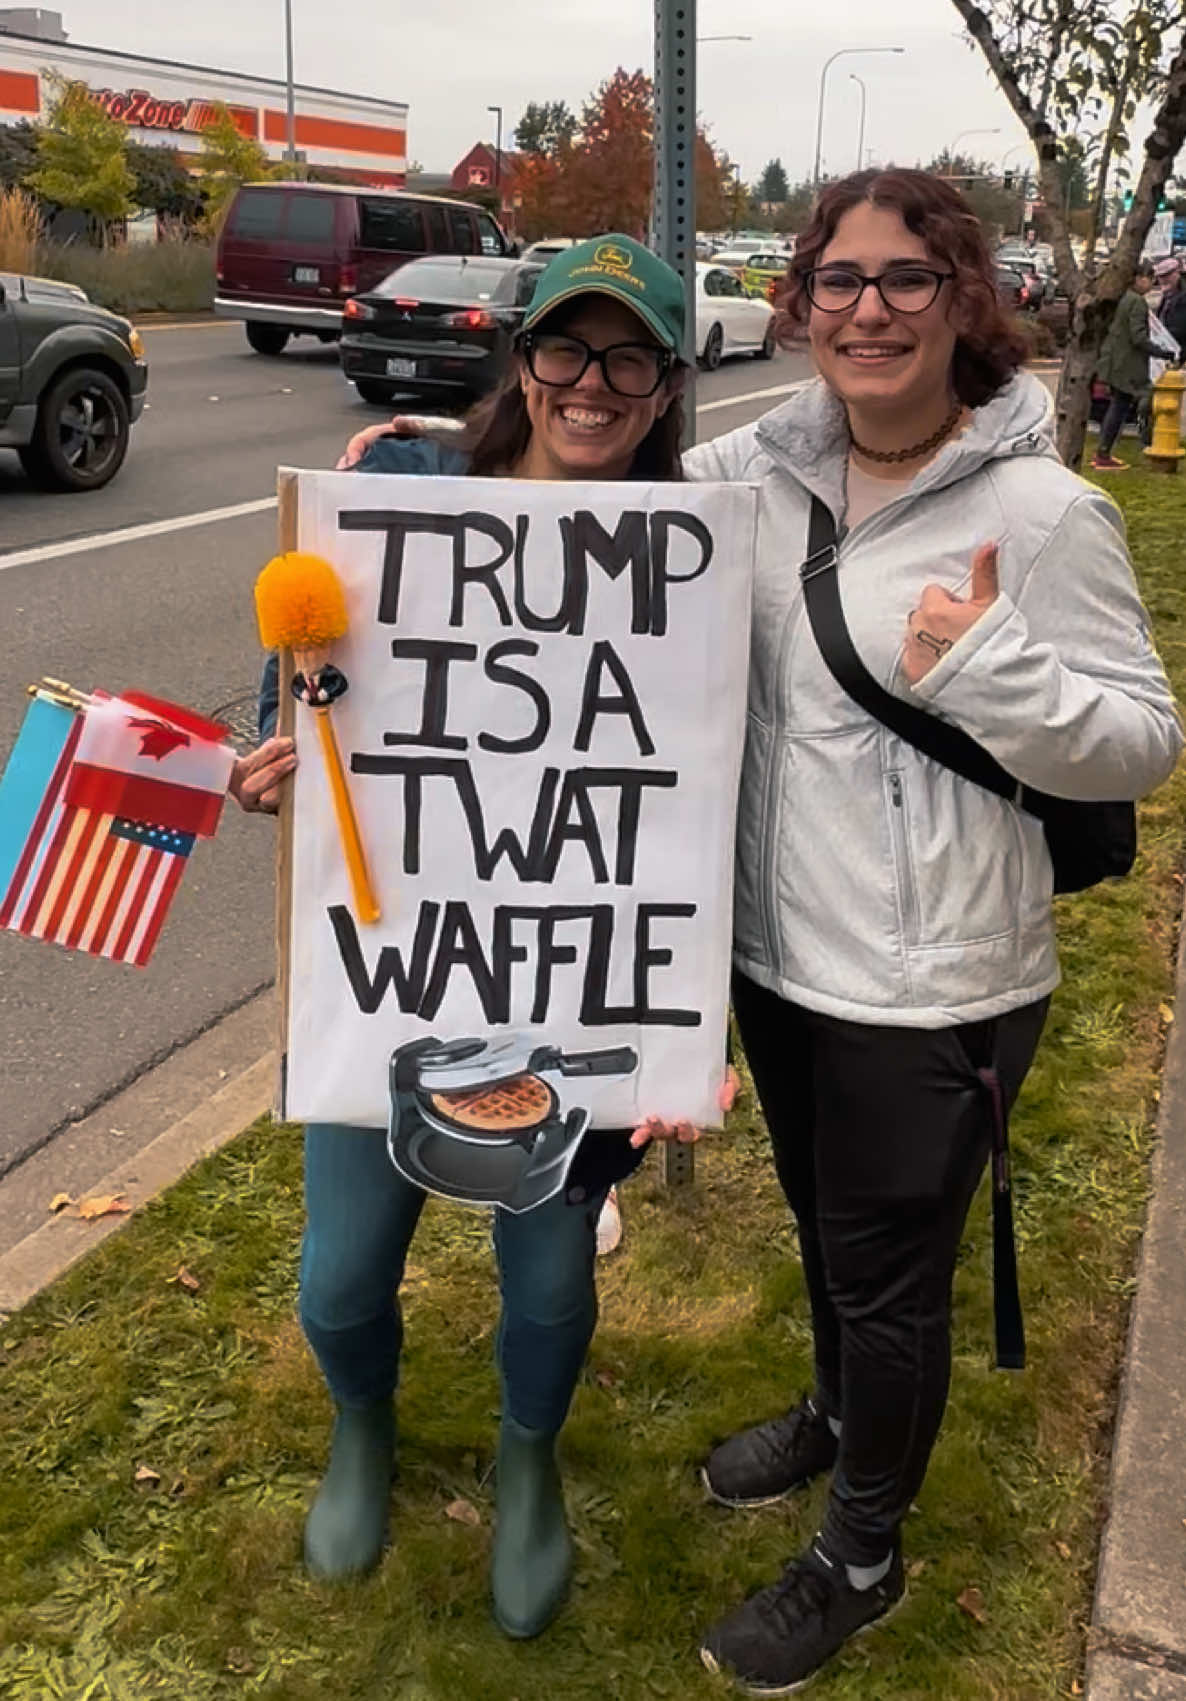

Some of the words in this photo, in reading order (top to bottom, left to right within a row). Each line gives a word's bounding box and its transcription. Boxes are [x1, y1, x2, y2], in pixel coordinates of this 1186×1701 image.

[76, 84, 186, 129] toZone
[338, 510, 713, 637] TRUMP
[384, 639, 551, 753] IS
[574, 639, 656, 756] A
[350, 753, 678, 885] TWAT
[327, 900, 701, 1026] WAFFLE
